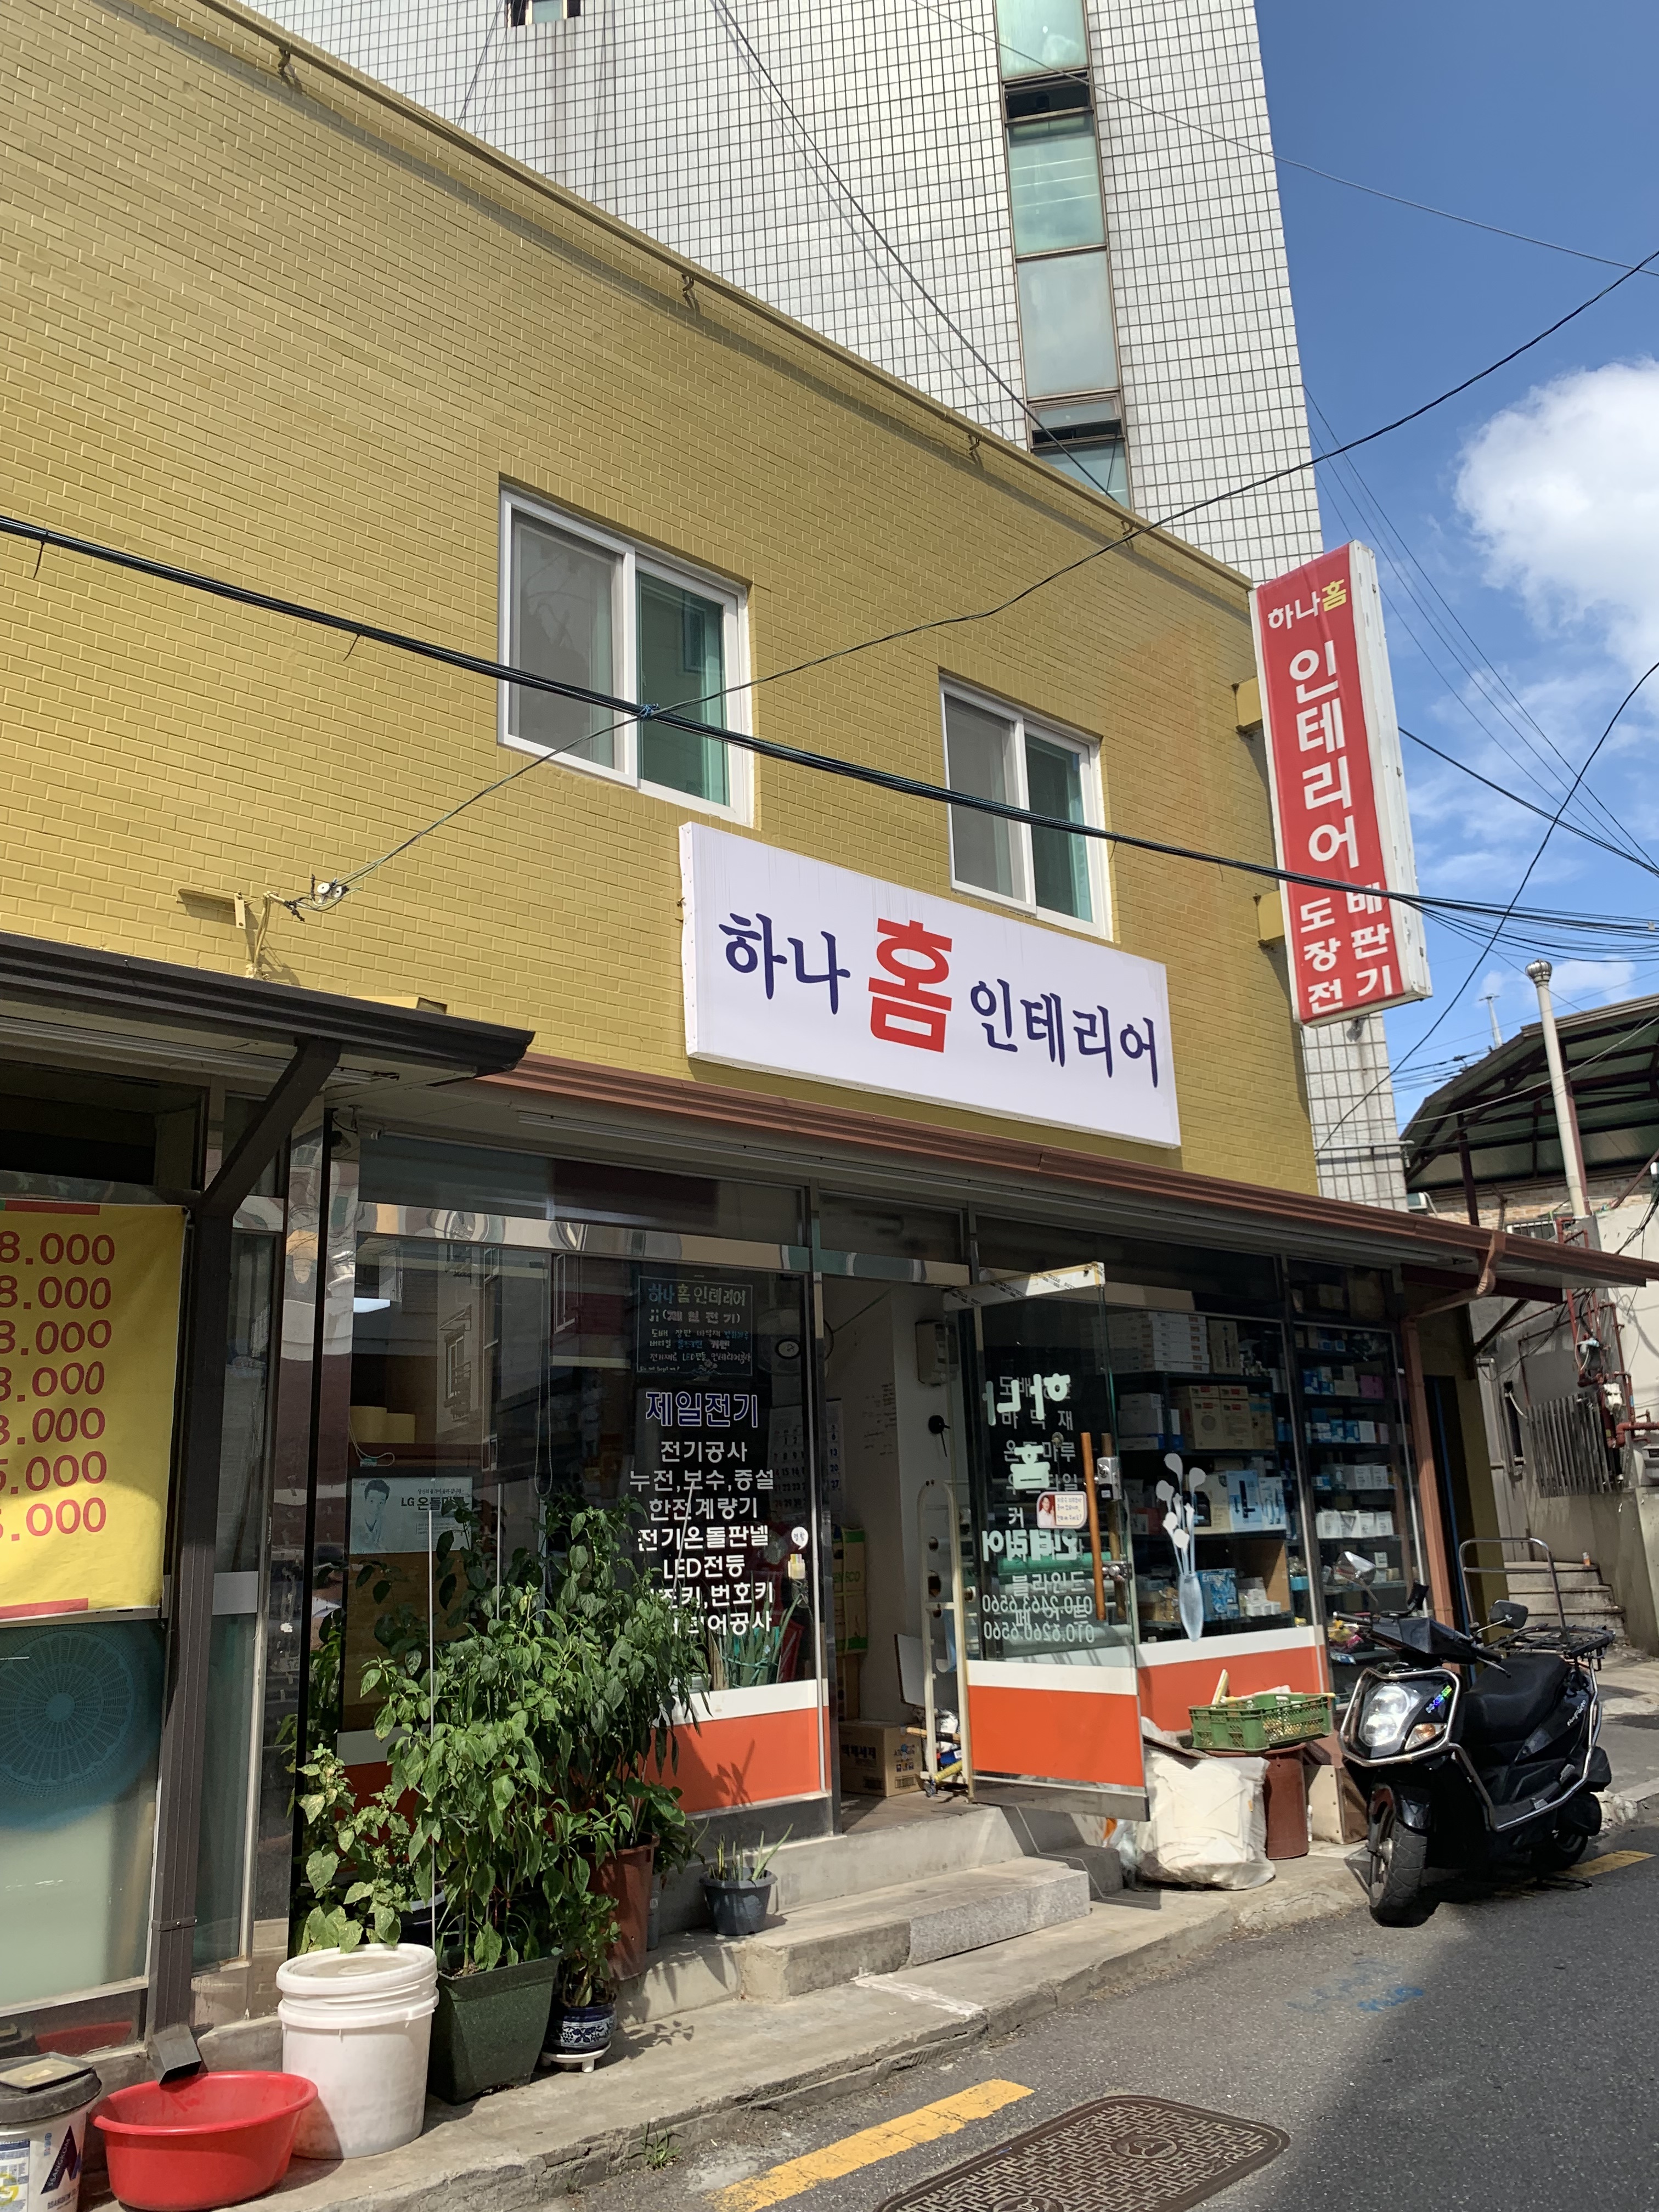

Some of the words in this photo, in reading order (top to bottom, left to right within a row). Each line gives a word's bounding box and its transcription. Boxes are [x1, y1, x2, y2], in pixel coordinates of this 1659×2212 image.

[1289, 640, 1359, 868] 인테리어
[1304, 923, 1390, 972] 장판
[718, 912, 850, 1015] 하나
[868, 917, 953, 1053] 홈
[970, 978, 1159, 1088] 인테리어
[1307, 964, 1392, 1014] 전기
[0, 1231, 115, 1266] 8.000
[0, 1275, 111, 1310] 8.000
[648, 1283, 675, 1304] 하나
[678, 1283, 691, 1304] 홈
[693, 1285, 747, 1307] 인테리어
[645, 1391, 758, 1428] 제일전기
[661, 1441, 747, 1463] 전기공사
[0, 1451, 107, 1494] .000
[630, 1469, 774, 1493] 누전,보수,증설
[0, 1497, 106, 1541] .000
[401, 1497, 415, 1506] LG
[417, 1497, 464, 1511] 온돌
[649, 1497, 758, 1521] 한전계량기
[637, 1525, 768, 1551] 전기온돌판넬
[663, 1554, 745, 1579] LED전등
[48, 2138, 71, 2187] SSANGKOM
